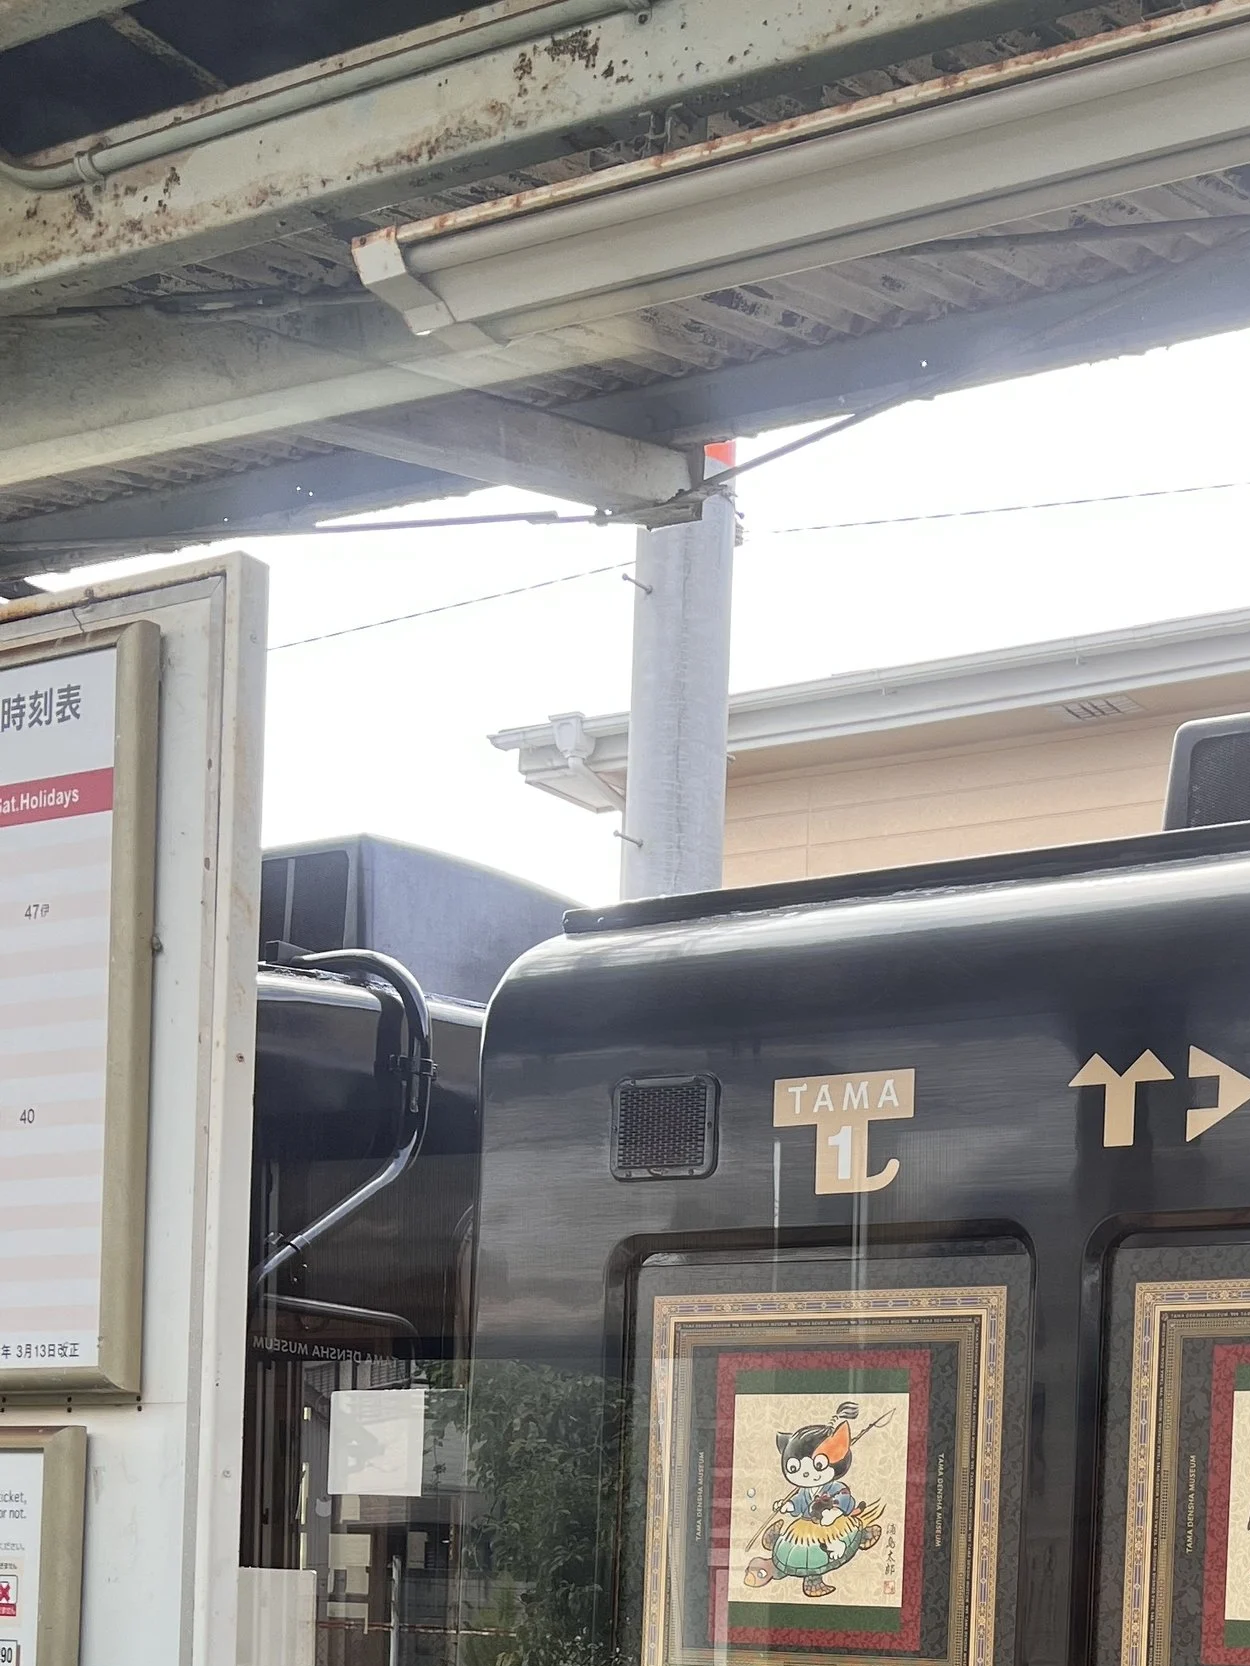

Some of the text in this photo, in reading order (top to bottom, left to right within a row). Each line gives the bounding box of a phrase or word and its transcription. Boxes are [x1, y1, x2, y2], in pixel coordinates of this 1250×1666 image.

[0, 683, 82, 733] 時刻表
[0, 787, 80, 814] at.Holidays
[787, 1079, 899, 1114] TAMA
[19, 1108, 35, 1124] 40
[827, 1125, 852, 1180] 1
[16, 1341, 80, 1359] 3月13日改正
[0, 1489, 27, 1506] cket,
[935, 1453, 945, 1548] TAMA DENSHA MUSEUM
[1185, 1455, 1197, 1554] TAMA DENSHA MUSEUM
